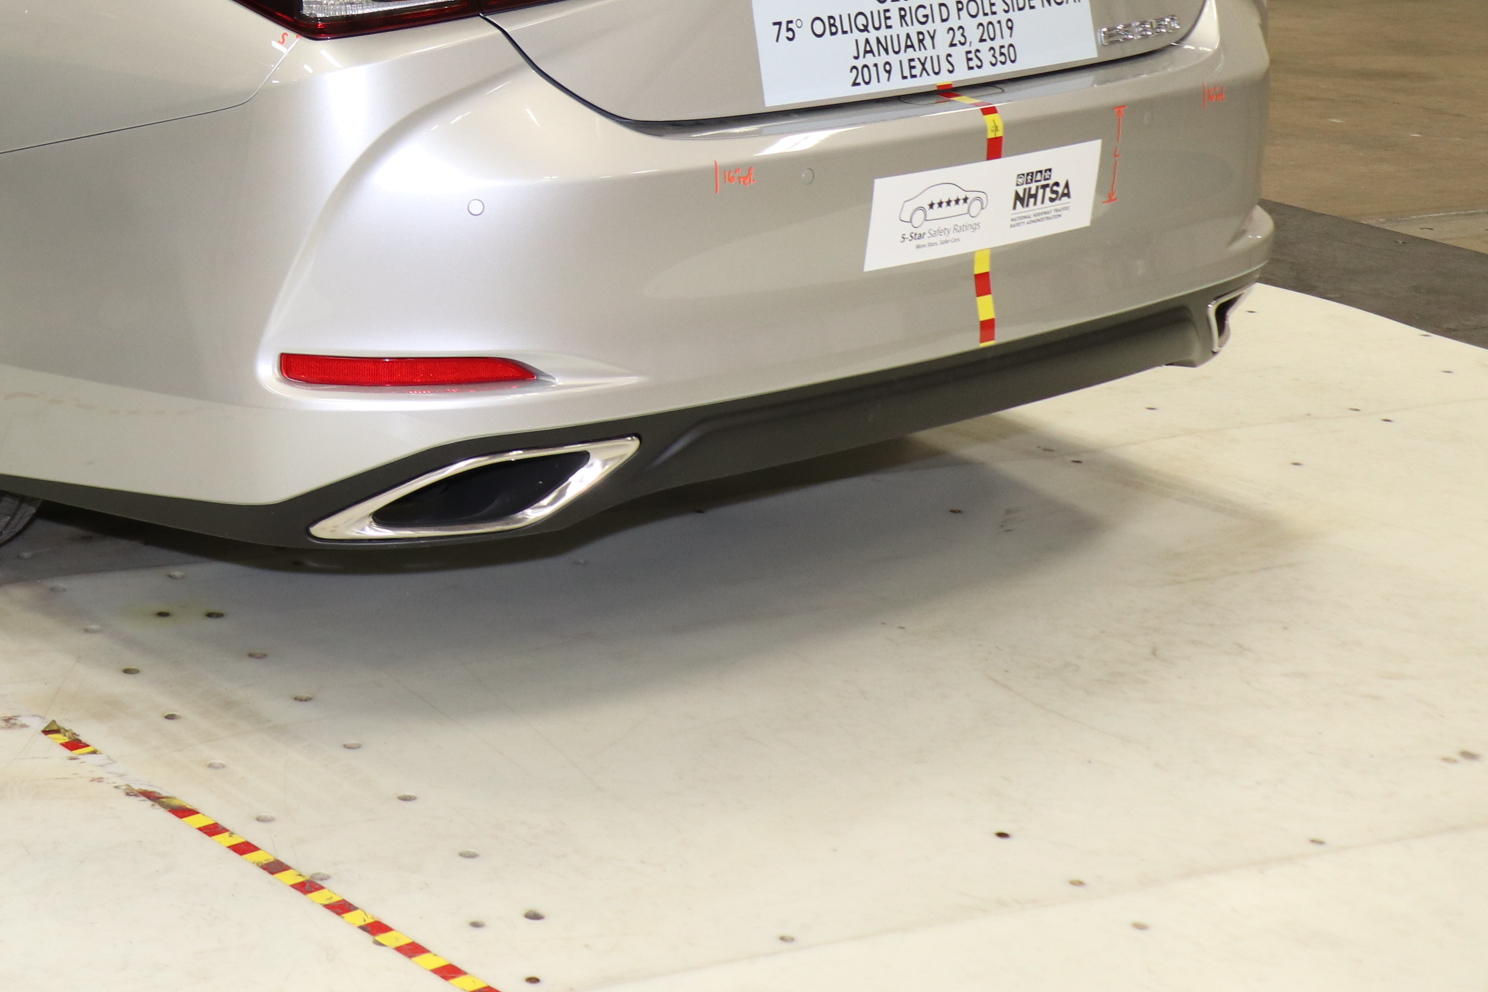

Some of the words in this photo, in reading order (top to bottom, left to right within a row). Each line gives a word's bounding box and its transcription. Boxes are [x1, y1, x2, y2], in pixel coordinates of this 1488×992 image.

[811, 7, 893, 38] OBLIQUE
[898, 2, 951, 27] RIGID
[852, 29, 937, 60] JANUARY
[947, 26, 973, 49] 23,
[977, 18, 1014, 44] 2019
[850, 61, 892, 87] 2019
[899, 53, 955, 81] LEXUS
[966, 49, 982, 72] ES
[989, 43, 1018, 67] 350
[1012, 179, 1071, 210] NHTSA
[900, 232, 926, 243] 5-Star
[927, 226, 951, 238] Safety
[953, 222, 981, 234] Ratings
